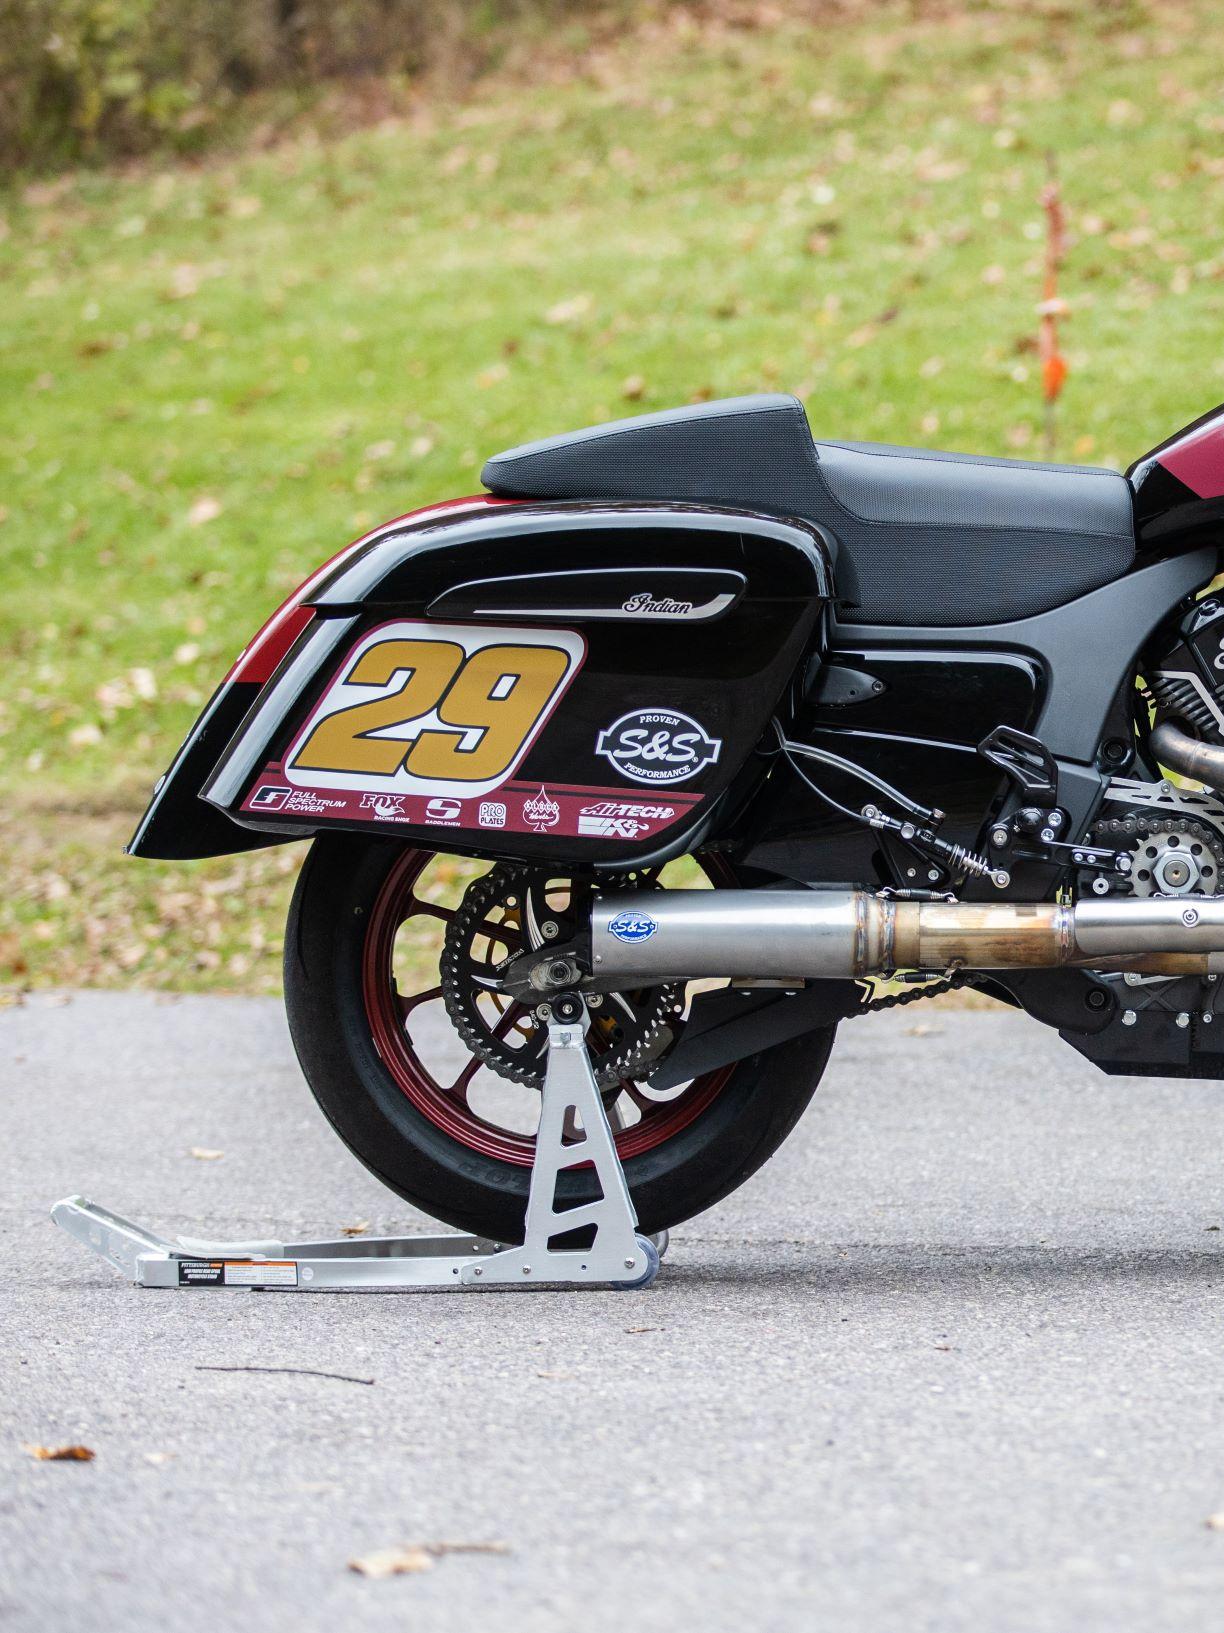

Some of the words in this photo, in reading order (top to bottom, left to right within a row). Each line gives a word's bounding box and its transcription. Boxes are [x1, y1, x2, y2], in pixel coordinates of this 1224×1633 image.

[622, 593, 692, 615] Indian
[288, 638, 571, 781] 29
[639, 715, 680, 726] PROVEN
[613, 728, 701, 762] S&S
[623, 762, 691, 779] PERFORMANCE
[291, 790, 317, 799] FULL
[285, 803, 325, 813] POWER
[287, 797, 347, 809] SPECTRUM
[359, 793, 406, 812] FOX
[480, 803, 505, 817] PRO
[424, 819, 461, 827] SADDLEMEN
[480, 817, 504, 825] PLATES
[592, 817, 650, 838] K&N
[616, 920, 651, 932] S&S
